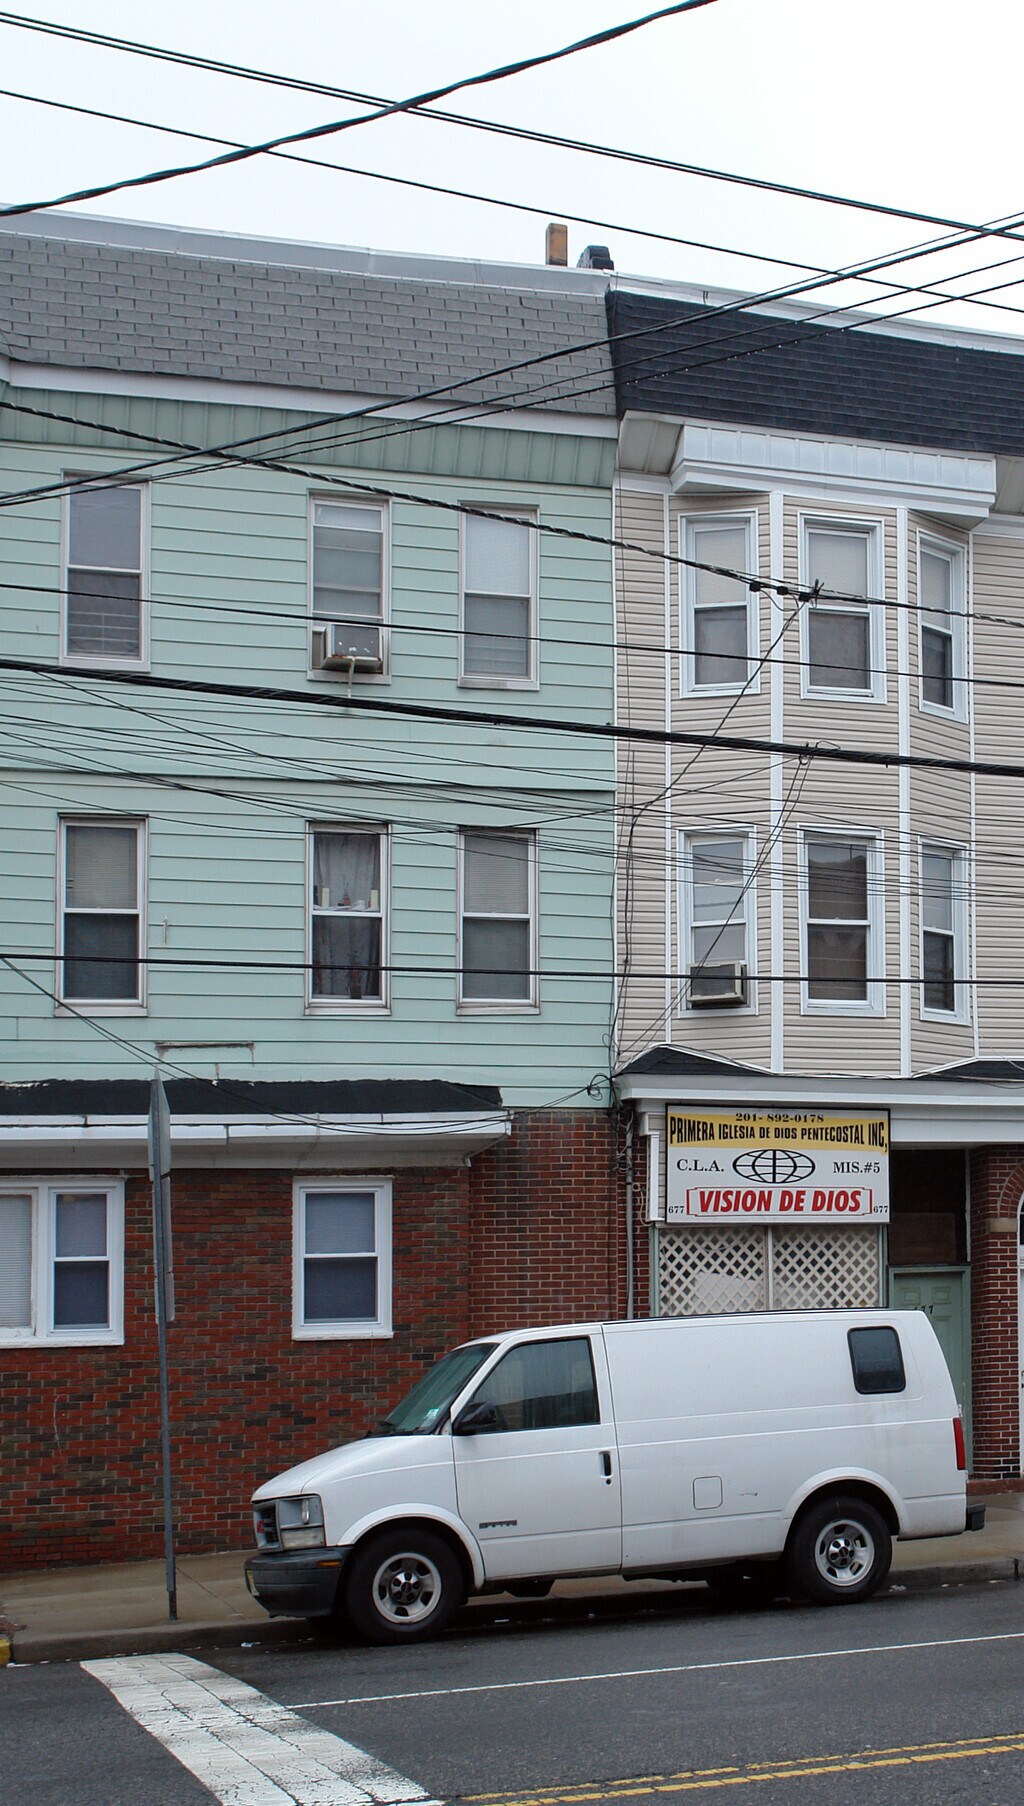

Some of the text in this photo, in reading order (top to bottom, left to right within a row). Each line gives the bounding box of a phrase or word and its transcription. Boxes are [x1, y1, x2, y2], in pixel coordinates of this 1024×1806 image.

[670, 1116, 715, 1144] PRIMERA
[718, 1123, 755, 1140] IGLESIA
[759, 1126, 770, 1139] DE
[774, 1127, 797, 1140] DIOS
[801, 1123, 865, 1145] PENTECOSTAL
[676, 1158, 725, 1173] C.L.A.
[833, 1161, 881, 1174] MIS.#5
[700, 1190, 862, 1213] VISION DE DIOS
[668, 1205, 685, 1214] 677
[873, 1205, 889, 1214] 677
